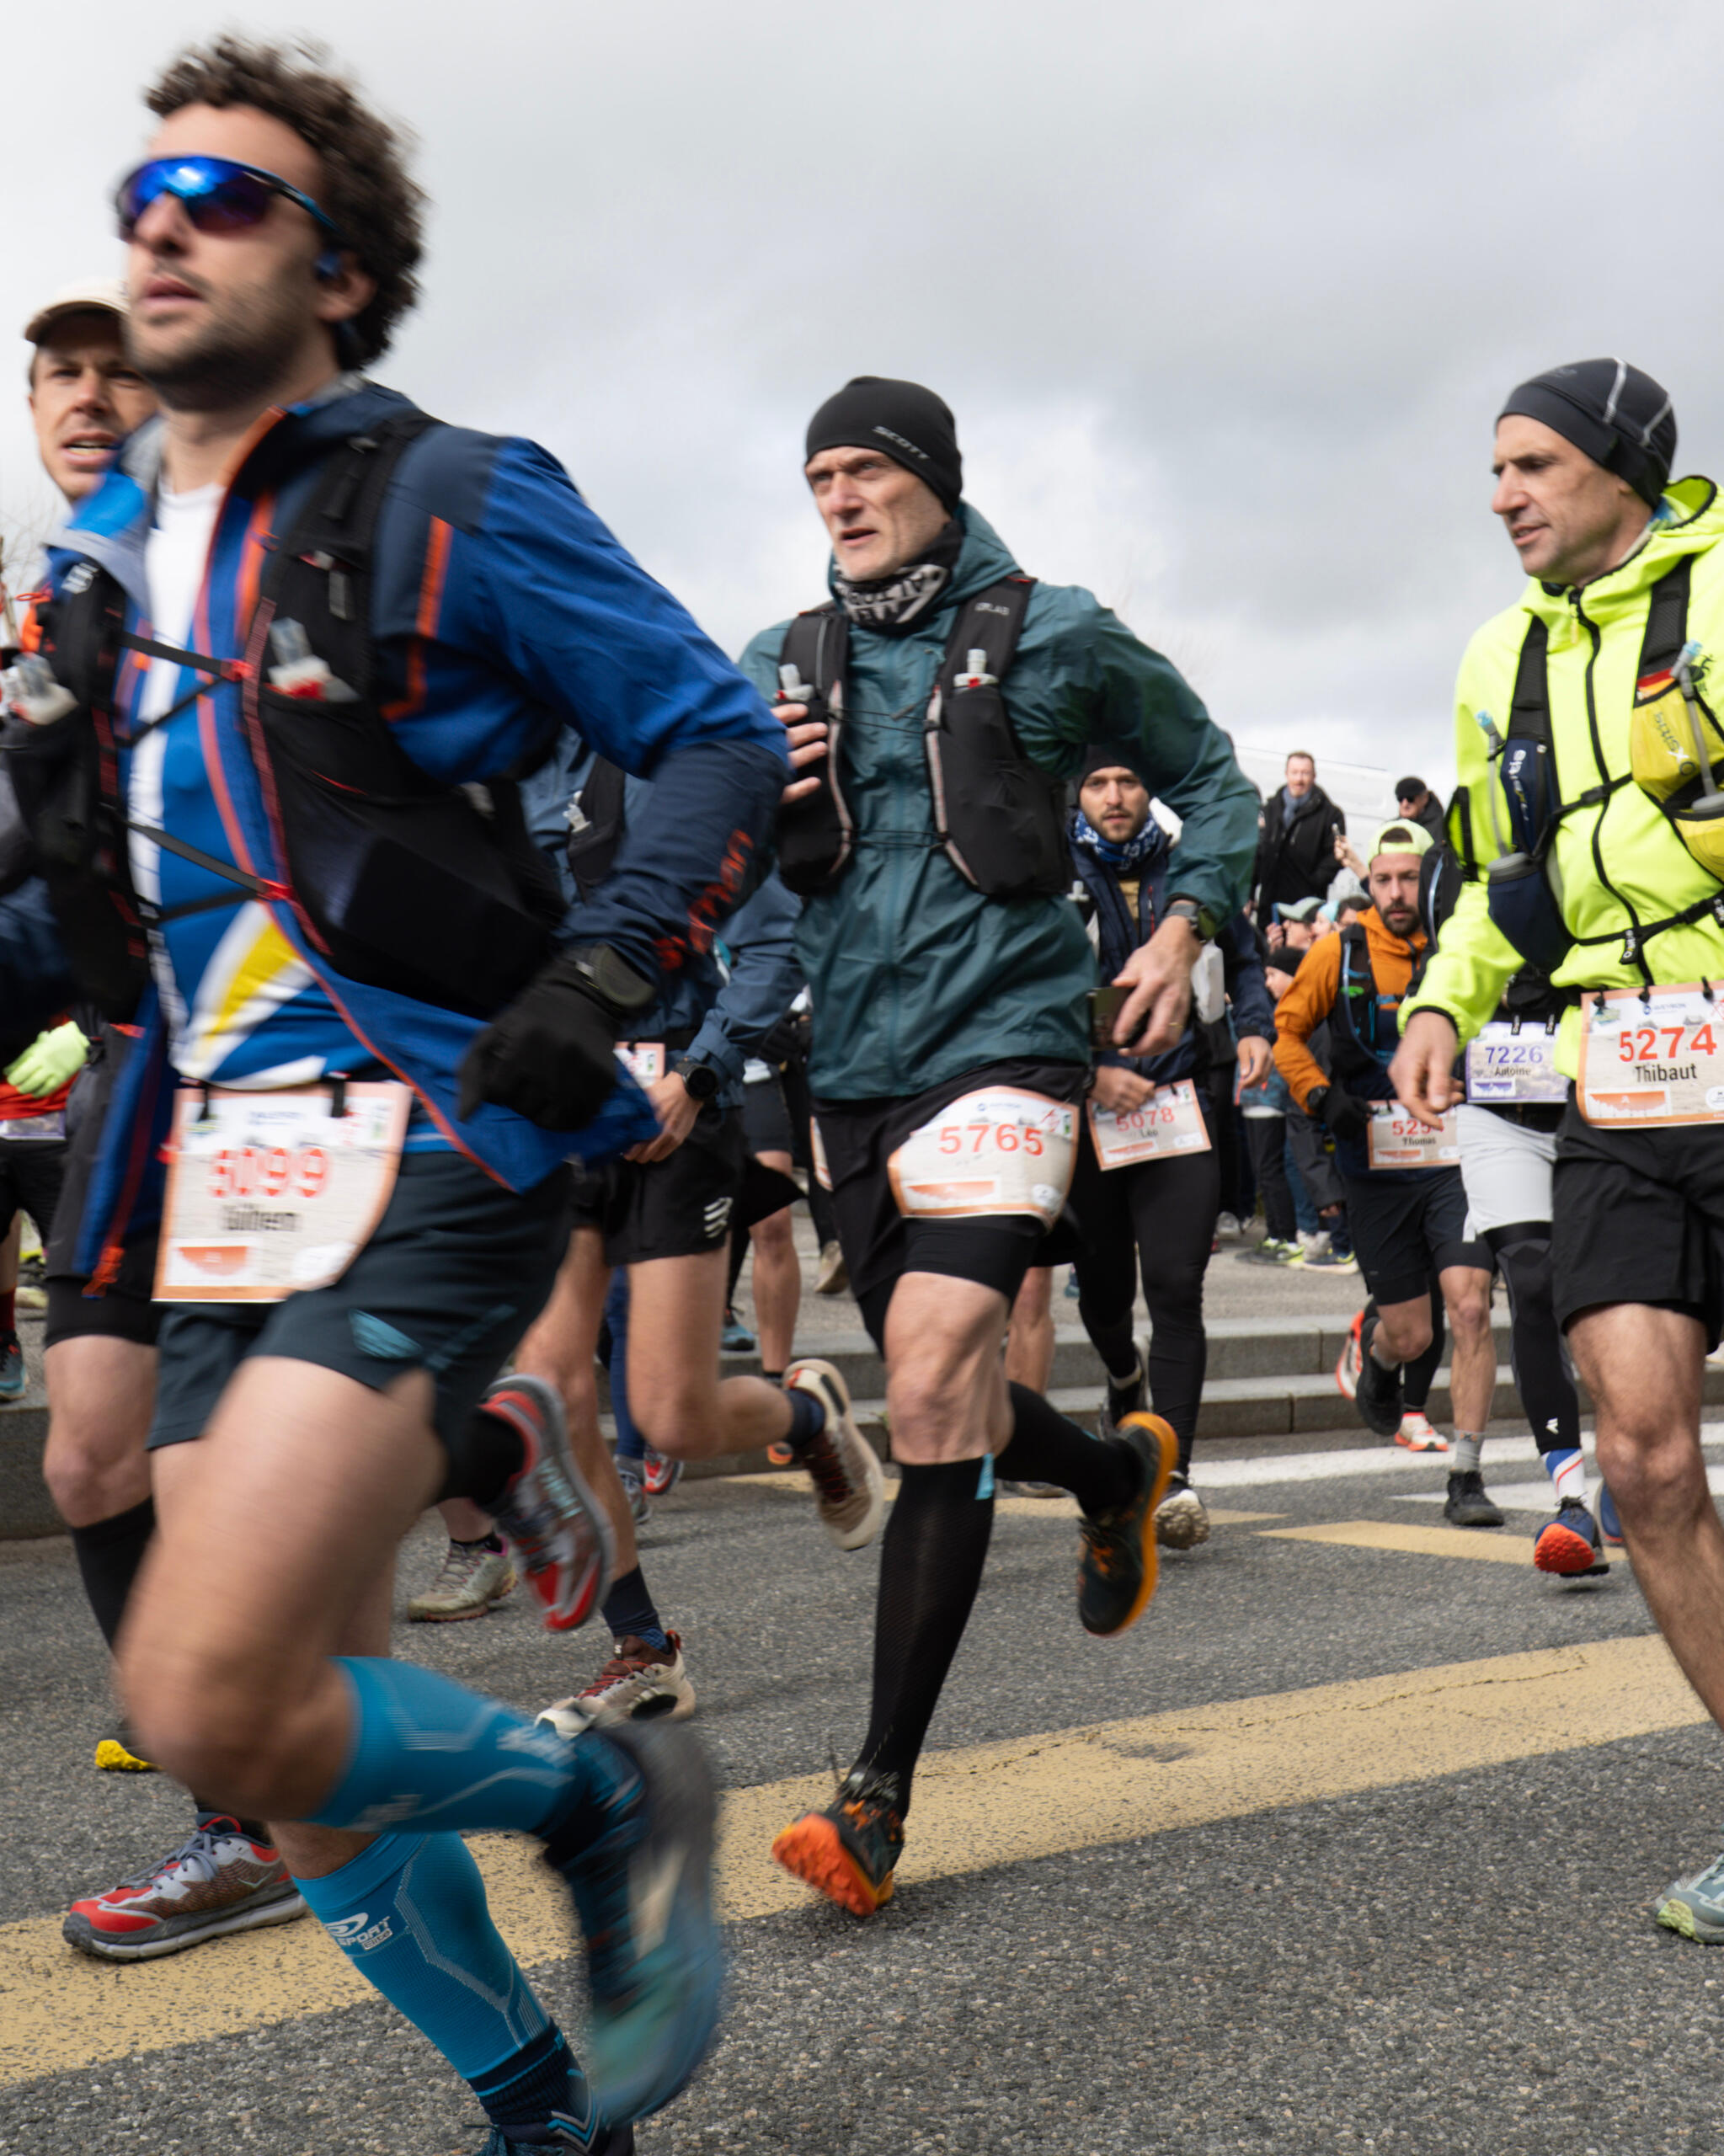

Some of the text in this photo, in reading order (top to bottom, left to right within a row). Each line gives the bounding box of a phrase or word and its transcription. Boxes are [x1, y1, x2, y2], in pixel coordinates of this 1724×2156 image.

[872, 425, 930, 459] SCOTT
[1485, 1045, 1543, 1064] 7226
[1619, 1023, 1717, 1063] 5274
[1635, 1063, 1698, 1082] Thibaut
[1116, 1107, 1175, 1132] 5078
[938, 1123, 1043, 1156] 5765
